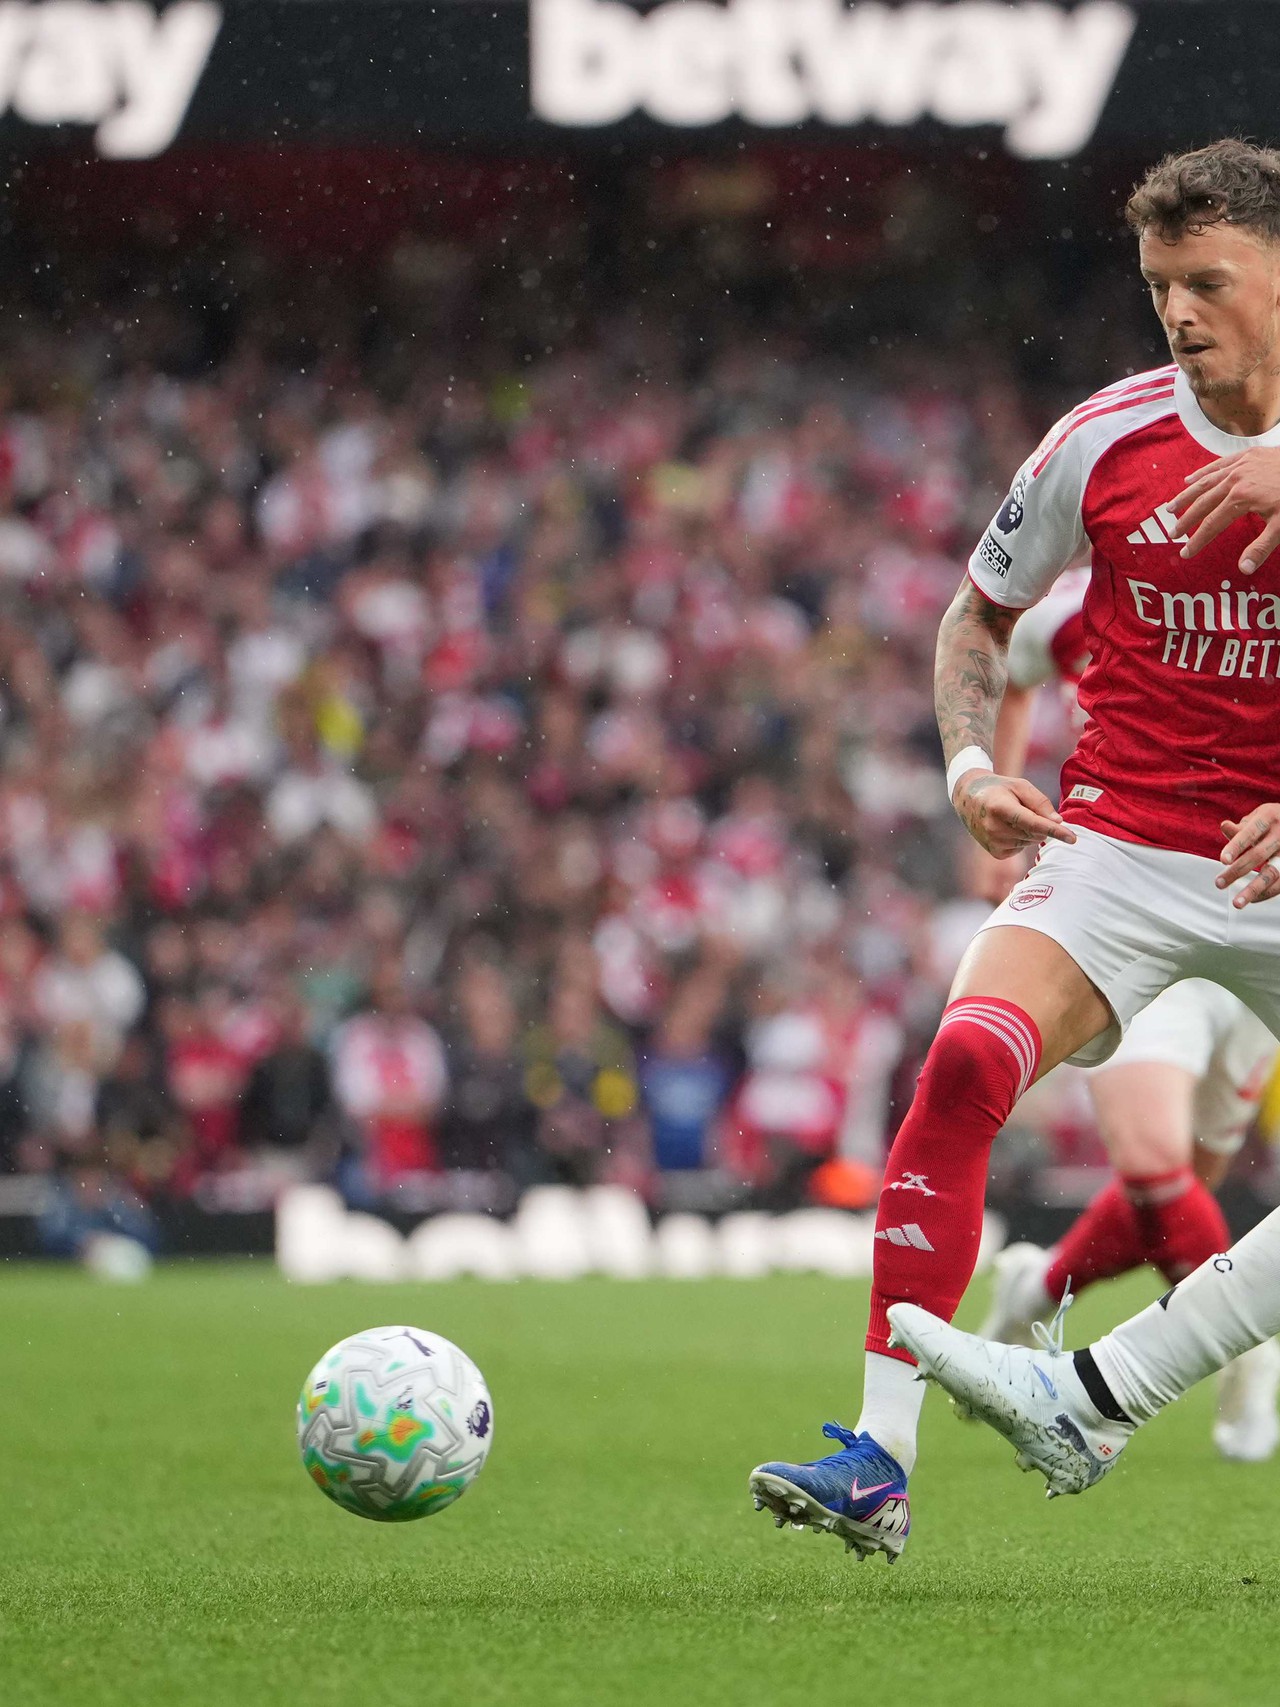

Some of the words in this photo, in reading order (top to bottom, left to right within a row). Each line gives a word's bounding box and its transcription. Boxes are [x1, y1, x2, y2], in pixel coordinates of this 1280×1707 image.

[0, 0, 223, 160] ay
[530, 0, 1135, 158] betway
[1161, 630, 1213, 672] FLY
